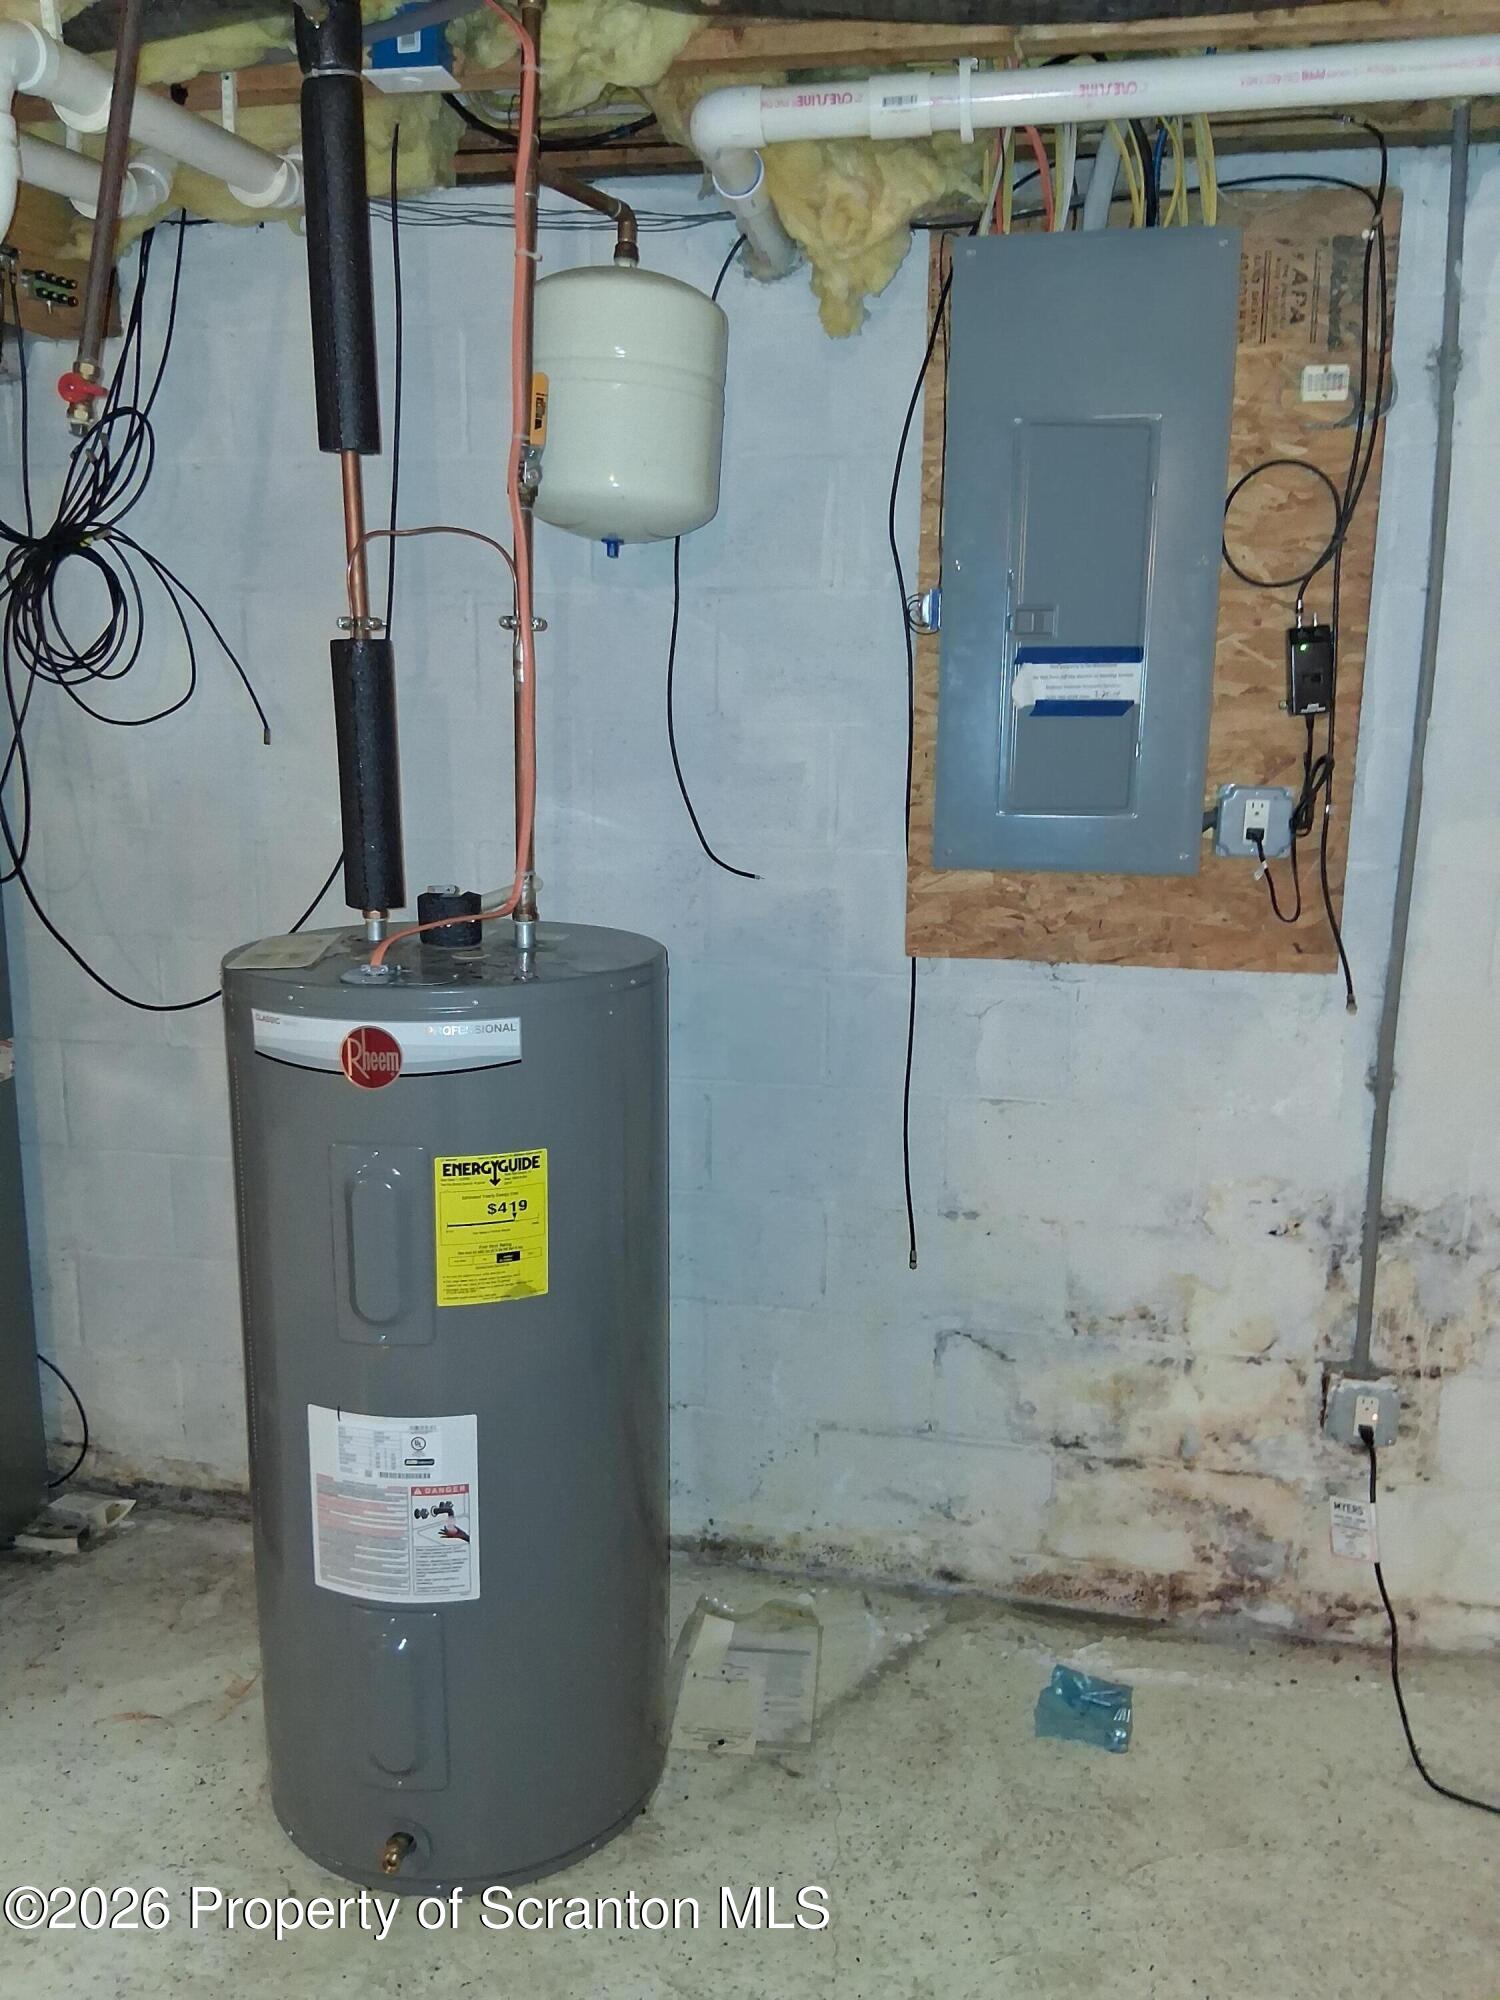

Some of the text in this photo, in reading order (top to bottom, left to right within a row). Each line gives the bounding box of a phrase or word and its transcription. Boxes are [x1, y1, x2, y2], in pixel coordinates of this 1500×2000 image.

[1290, 268, 1308, 324] APA
[348, 1028, 400, 1079] Rheem
[442, 1155, 541, 1177] ENERGYGUIDE
[487, 1199, 528, 1215] $419
[424, 1485, 466, 1495] DANGER
[1333, 1501, 1363, 1515] MYERS
